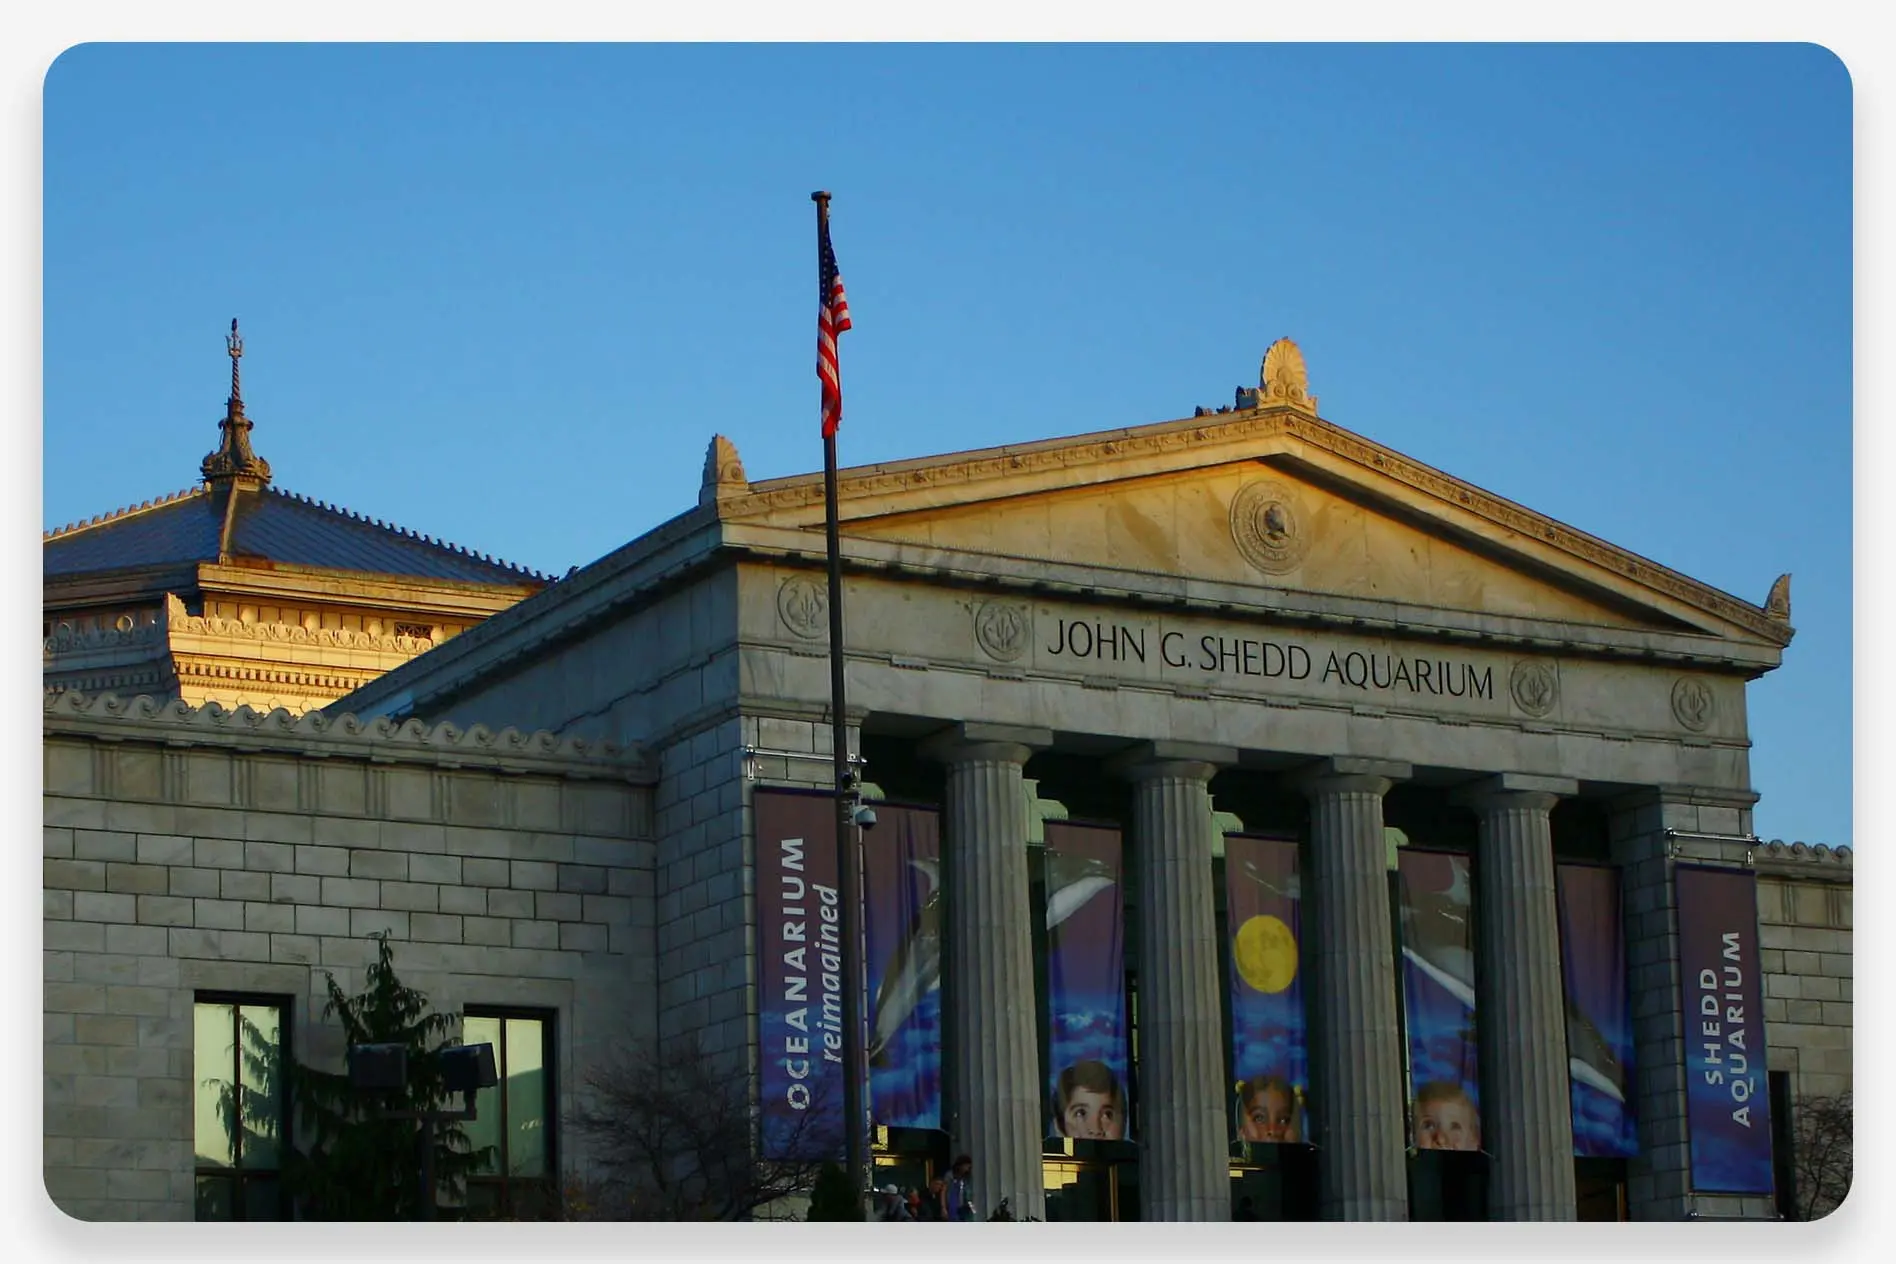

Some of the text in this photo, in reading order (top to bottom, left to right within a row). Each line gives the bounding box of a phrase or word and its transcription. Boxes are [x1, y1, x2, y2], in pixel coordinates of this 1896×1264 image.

[1047, 619, 1494, 700] JOHN G. SHEDD AQUARIUM
[781, 837, 811, 1110] OCEANARIUM
[1700, 968, 1724, 1085] SHEDD
[1722, 931, 1755, 1128] AQUARIUM
